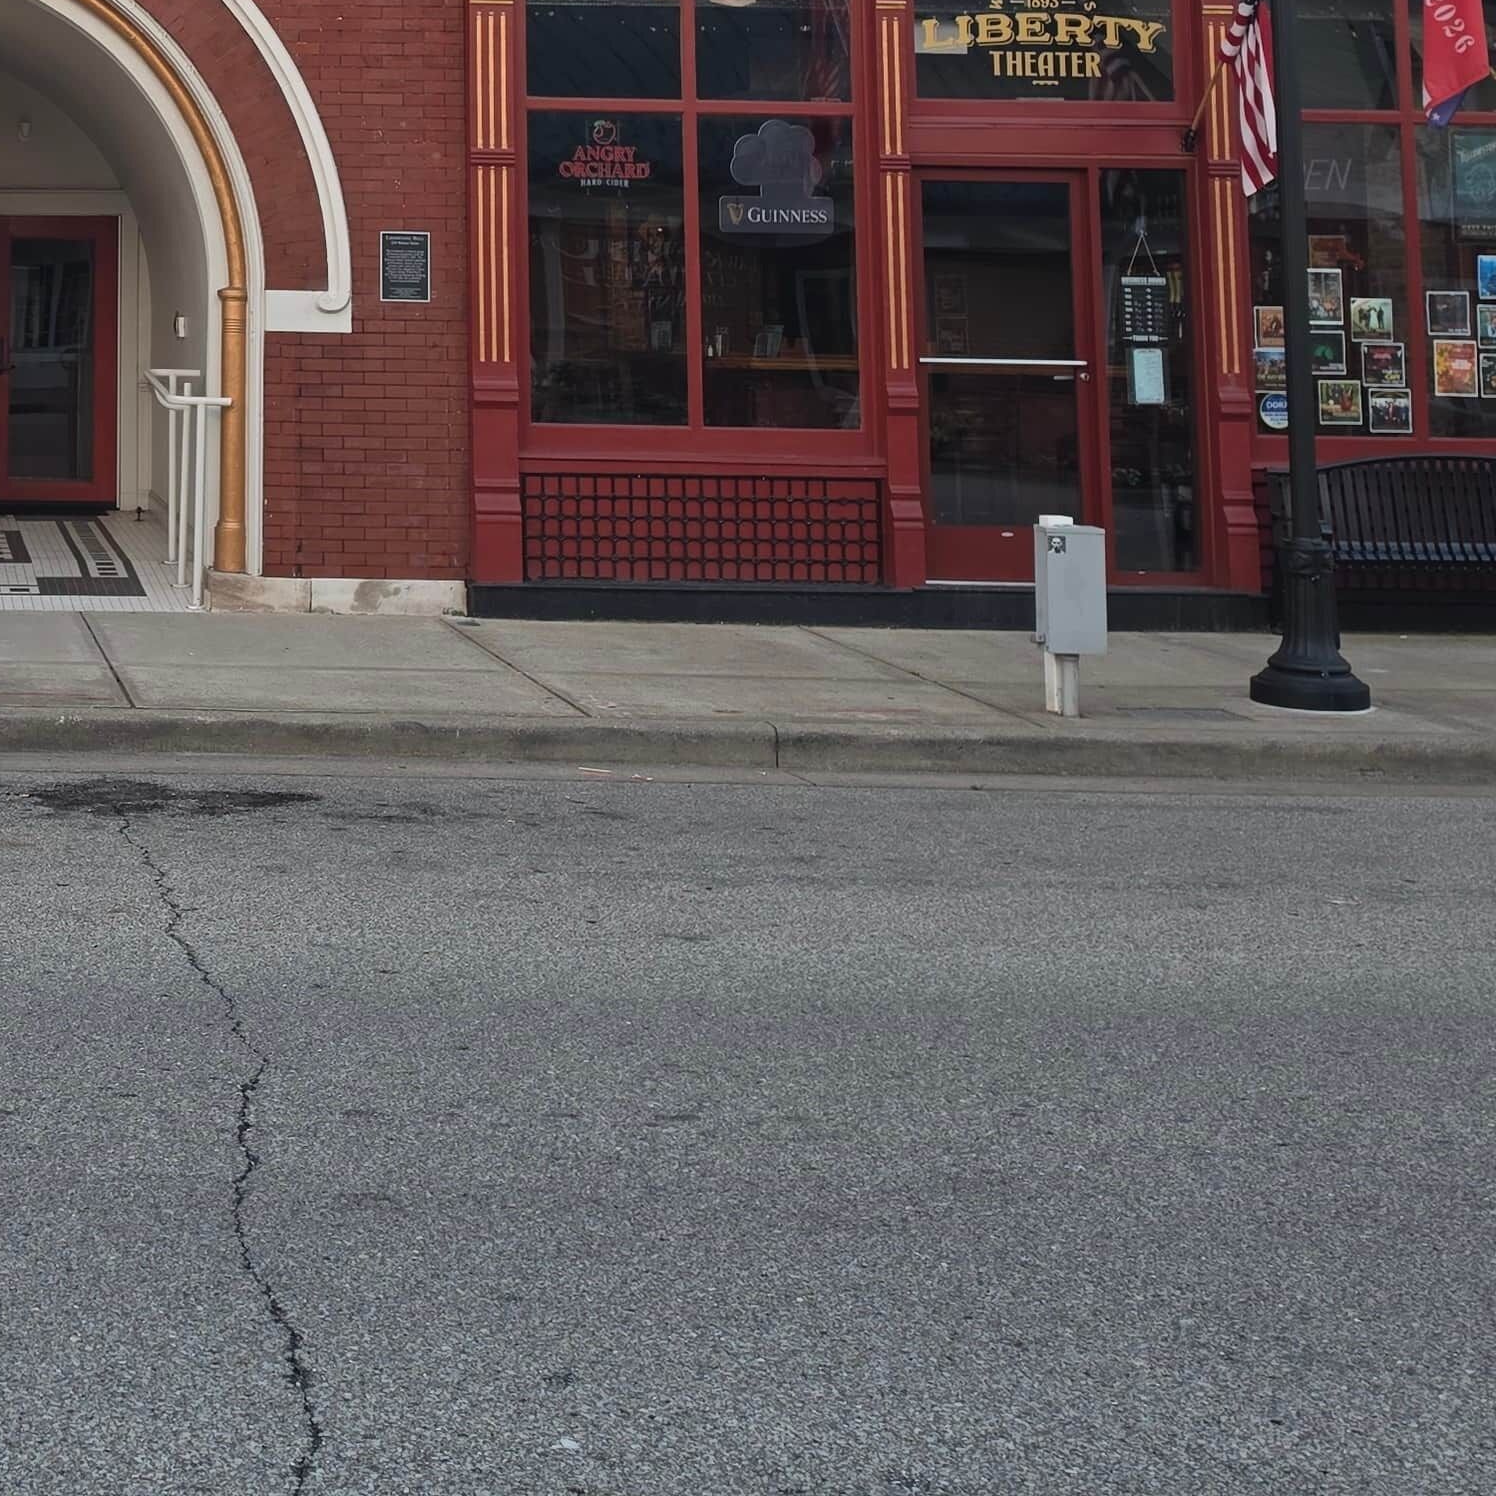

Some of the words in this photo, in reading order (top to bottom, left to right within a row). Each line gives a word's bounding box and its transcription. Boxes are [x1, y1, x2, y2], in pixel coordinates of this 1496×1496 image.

[921, 12, 1166, 54] LIBERTY
[989, 50, 1103, 78] THEATER
[573, 145, 637, 162] ANGRY
[559, 160, 651, 178] ORCHARD
[1303, 157, 1353, 191] EN
[580, 178, 602, 187] HARD
[606, 178, 630, 188] CIDER
[747, 205, 828, 225] GUINNESS
